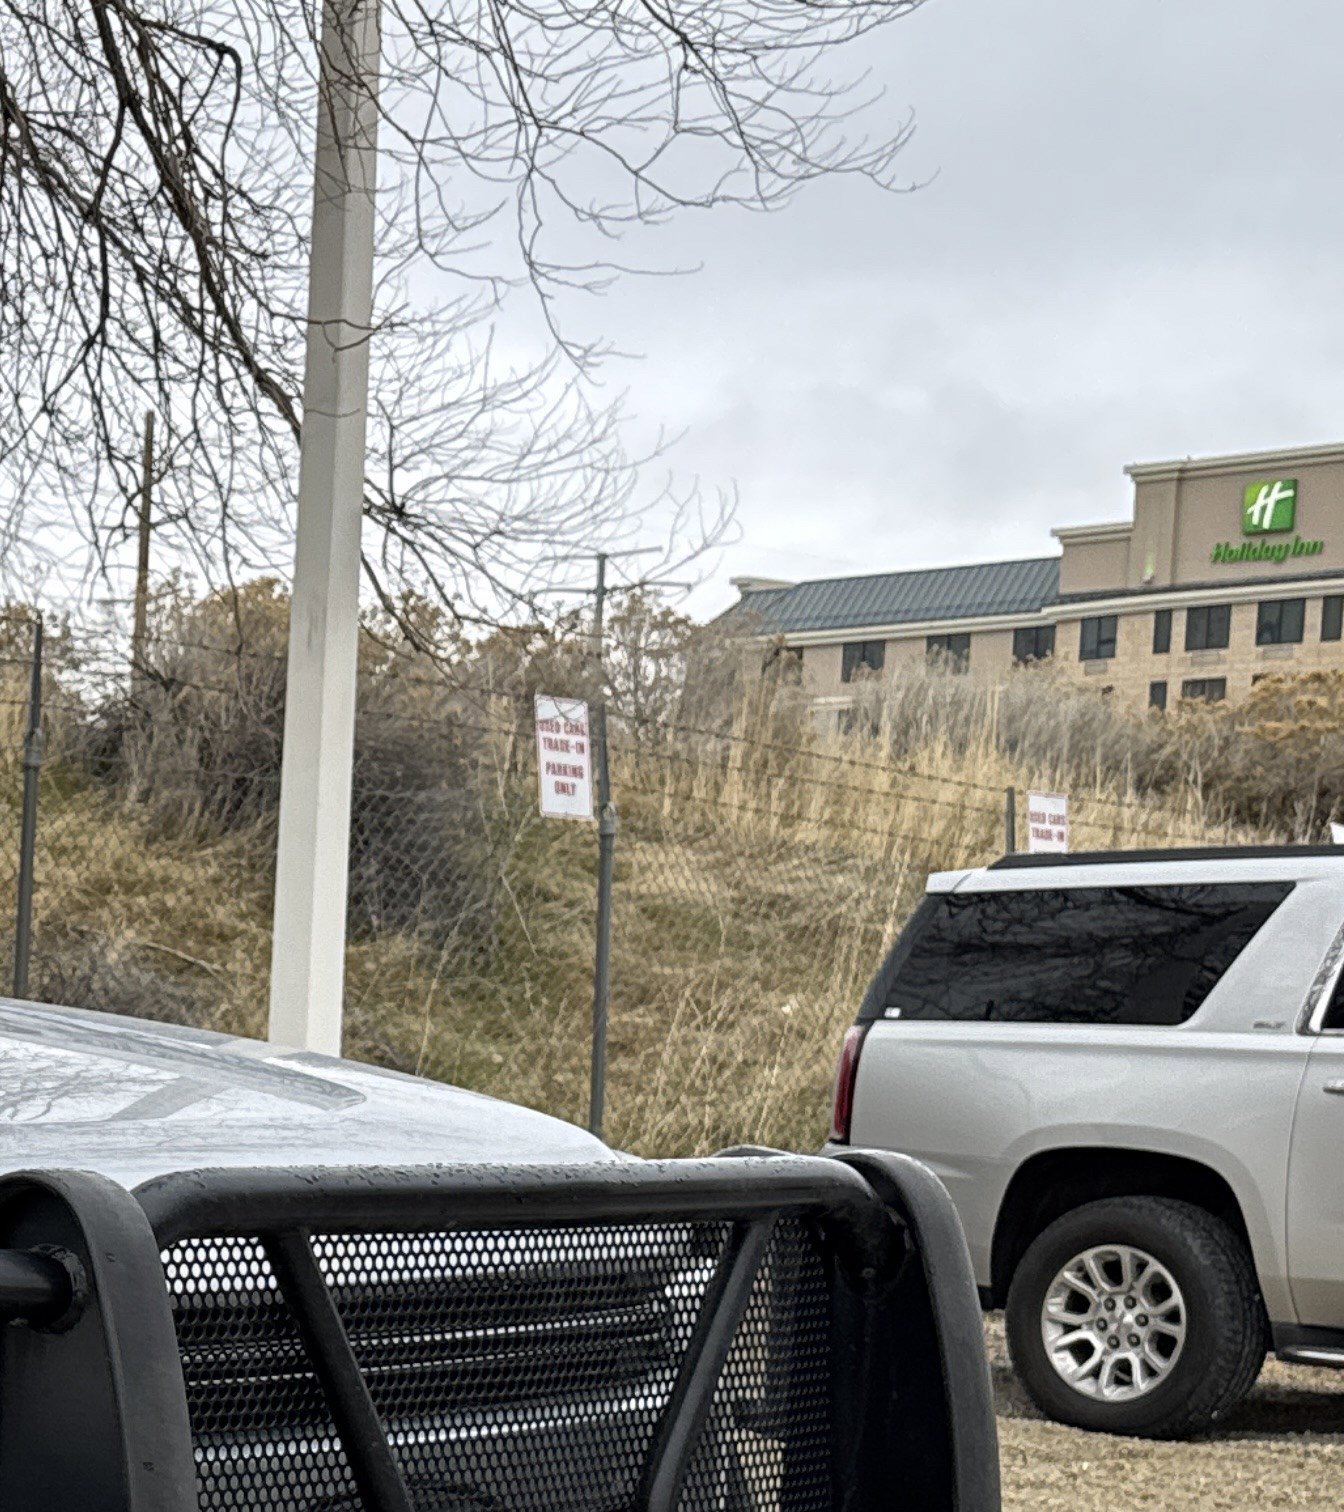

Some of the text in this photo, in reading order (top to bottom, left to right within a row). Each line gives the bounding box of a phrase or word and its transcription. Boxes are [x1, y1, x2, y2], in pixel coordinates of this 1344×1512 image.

[1211, 535, 1324, 564] Holiday Inn
[538, 719, 587, 736] USED CARS
[542, 736, 585, 754] TRADE-IN
[545, 761, 584, 779] PARKING
[554, 780, 576, 796] ONLY
